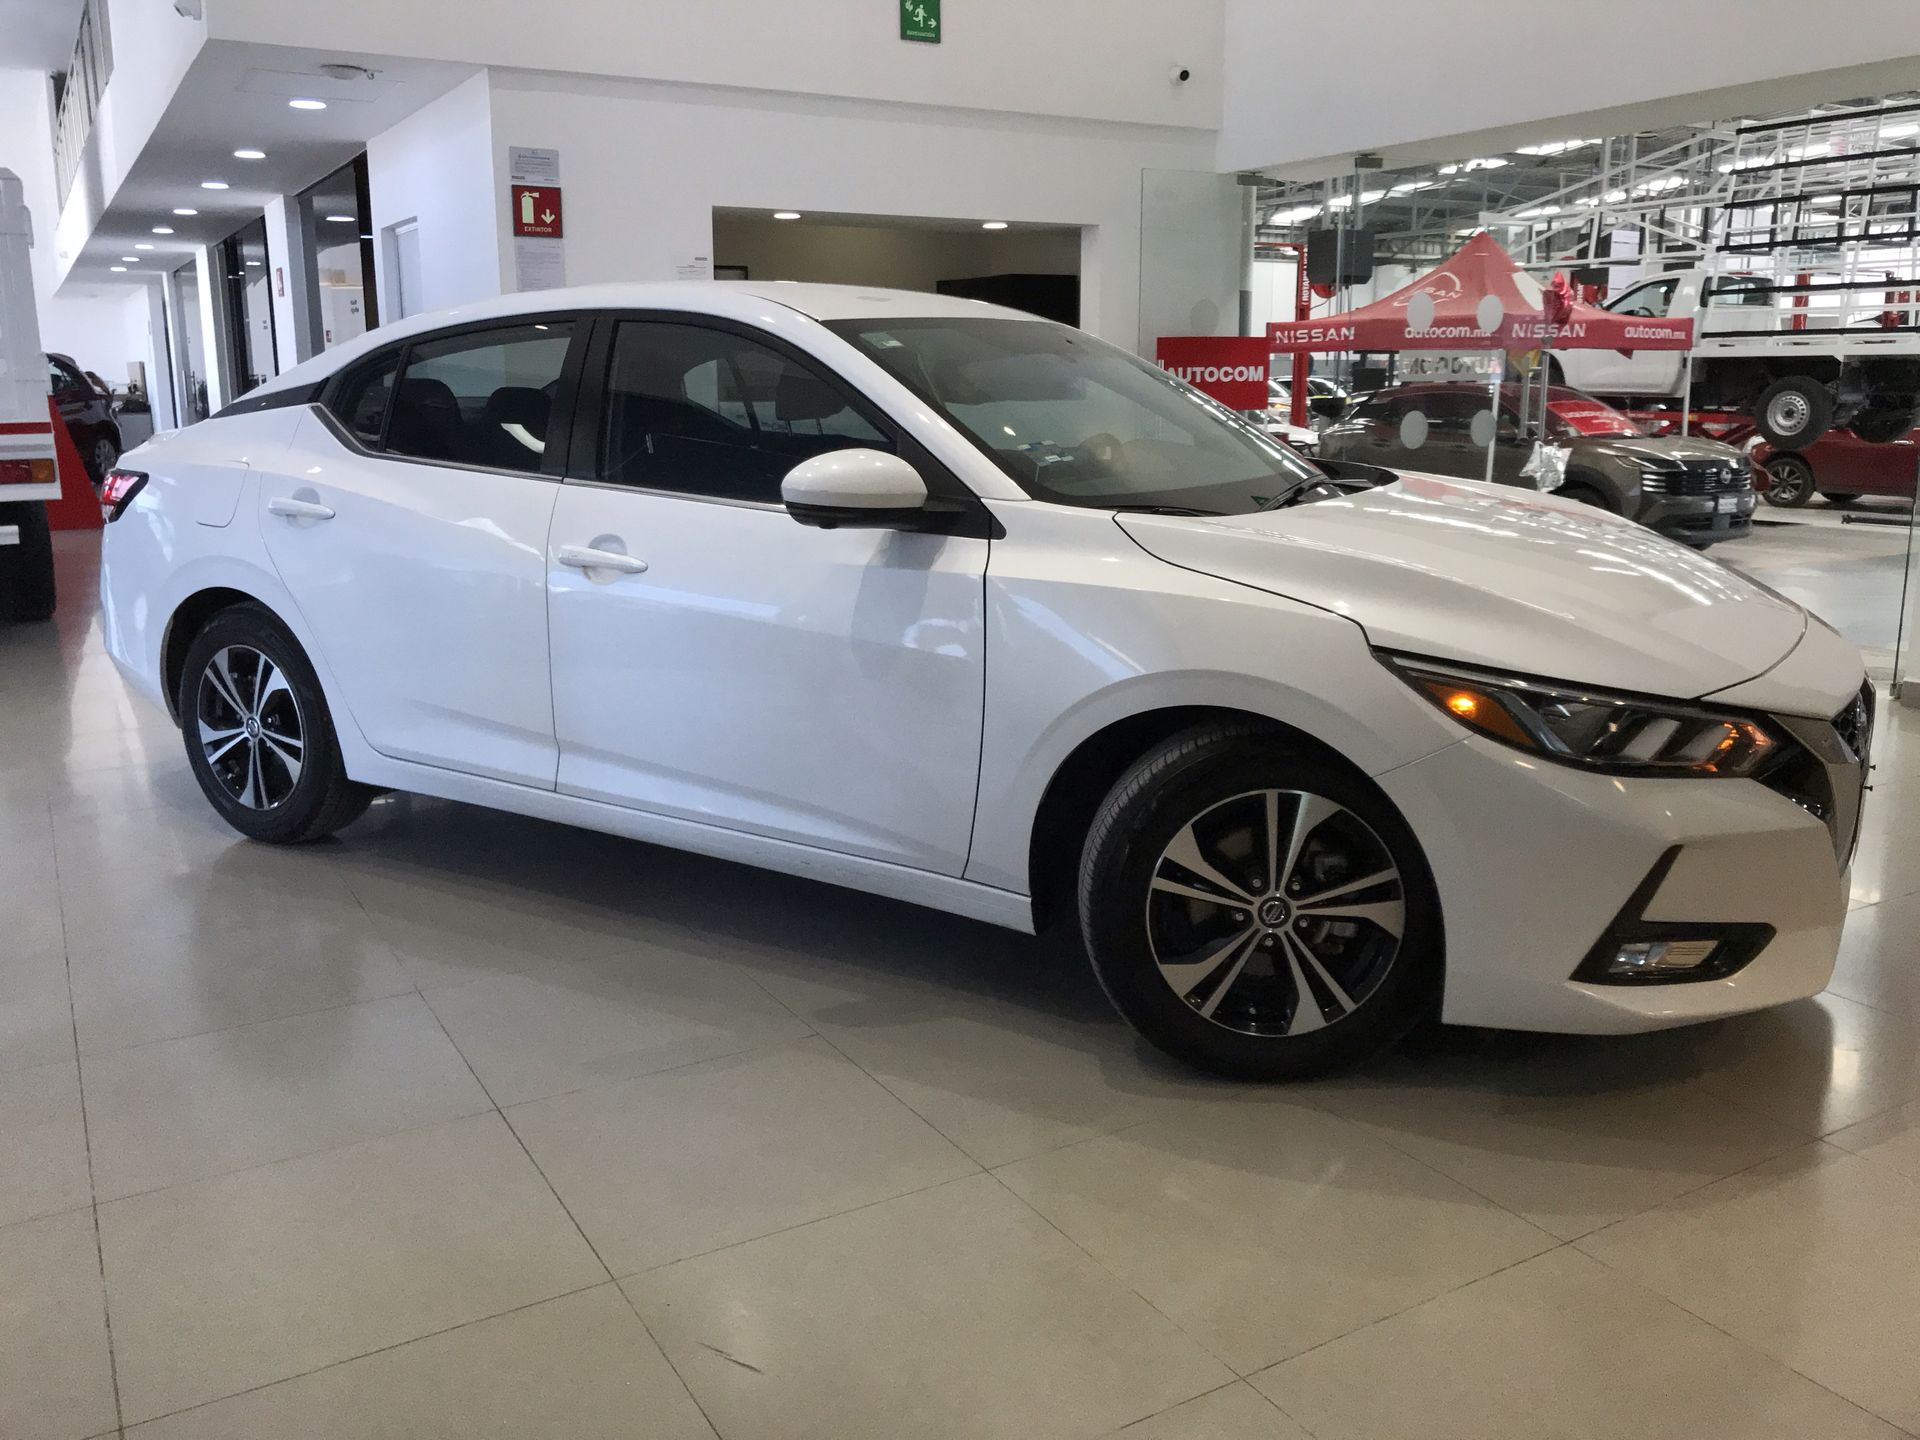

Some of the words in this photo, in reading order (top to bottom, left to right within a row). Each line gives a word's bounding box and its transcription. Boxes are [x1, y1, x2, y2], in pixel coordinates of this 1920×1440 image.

[1275, 326, 1355, 344] NISSAN
[1512, 323, 1586, 338] NISSAN
[1624, 325, 1686, 340] autocom.mx
